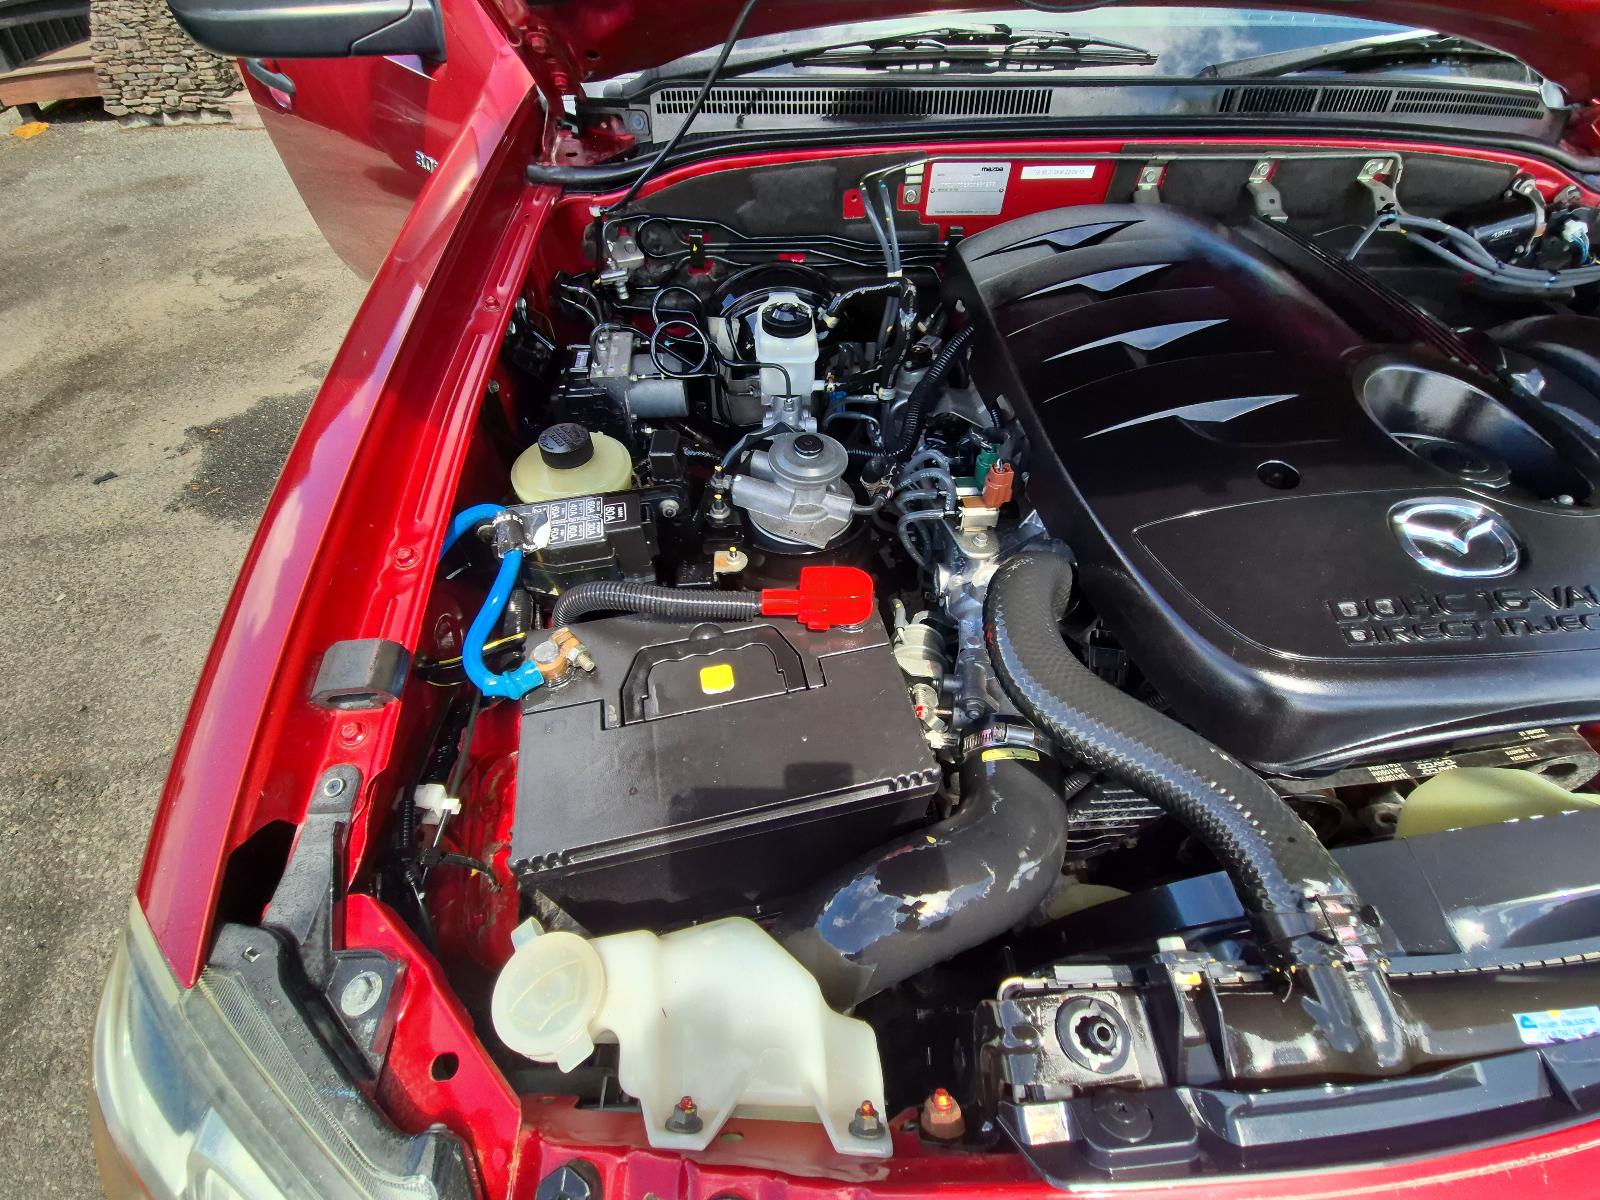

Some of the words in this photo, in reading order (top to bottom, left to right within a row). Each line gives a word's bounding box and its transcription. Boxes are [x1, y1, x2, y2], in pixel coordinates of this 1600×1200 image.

[605, 506, 616, 521] 80A
[1328, 592, 1478, 623] DOHC
[1341, 618, 1487, 647] DIRECT
